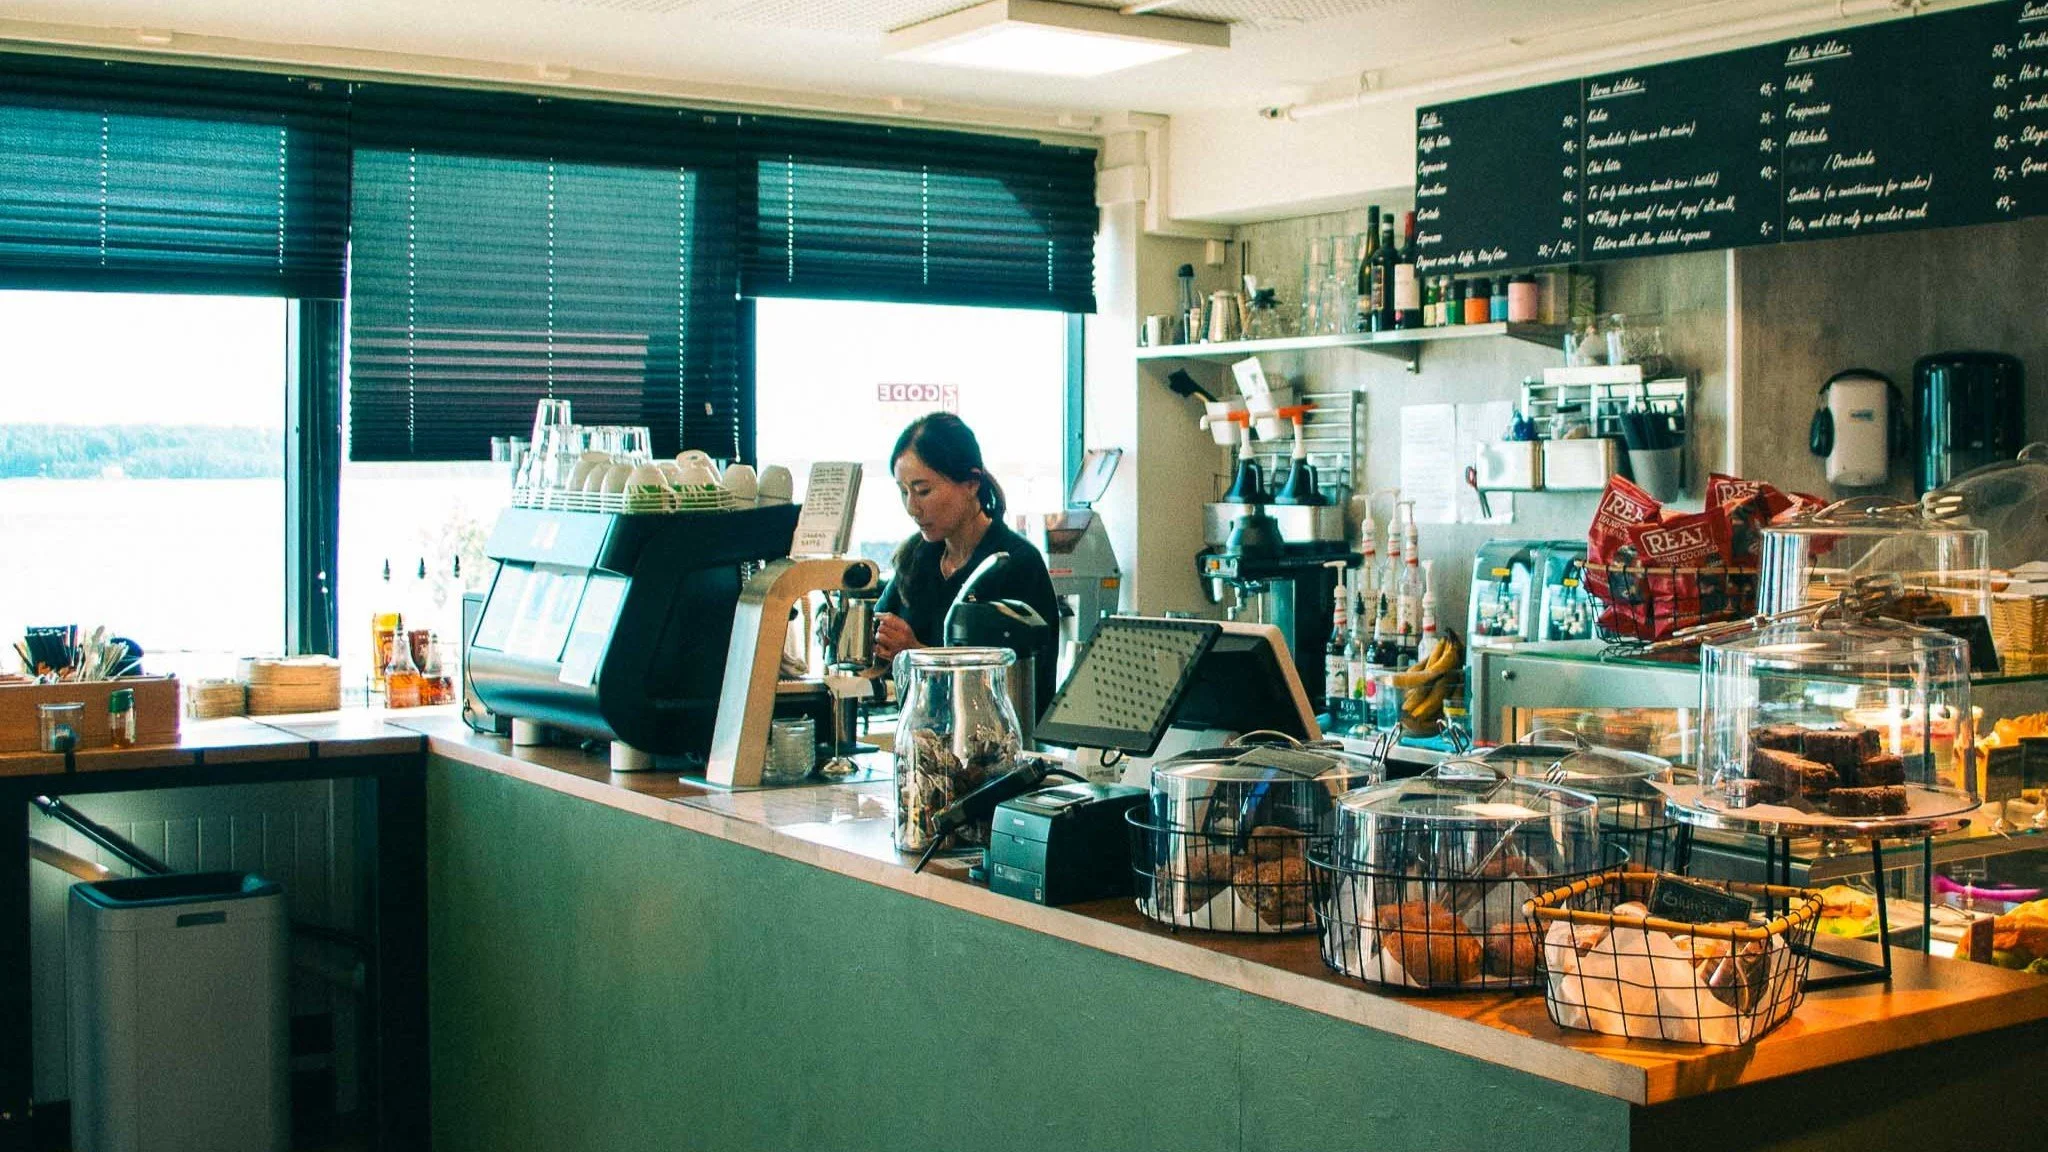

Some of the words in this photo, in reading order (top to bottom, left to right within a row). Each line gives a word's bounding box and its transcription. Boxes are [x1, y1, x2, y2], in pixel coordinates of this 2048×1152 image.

[1992, 44, 2012, 59] 50,-
[1587, 109, 1608, 123] Kakao
[1786, 128, 1827, 148] Milkshake
[1885, 179, 1898, 196] for
[1619, 233, 1636, 247] melk
[1605, 494, 1645, 523] REA
[1645, 527, 1711, 554] REAL
